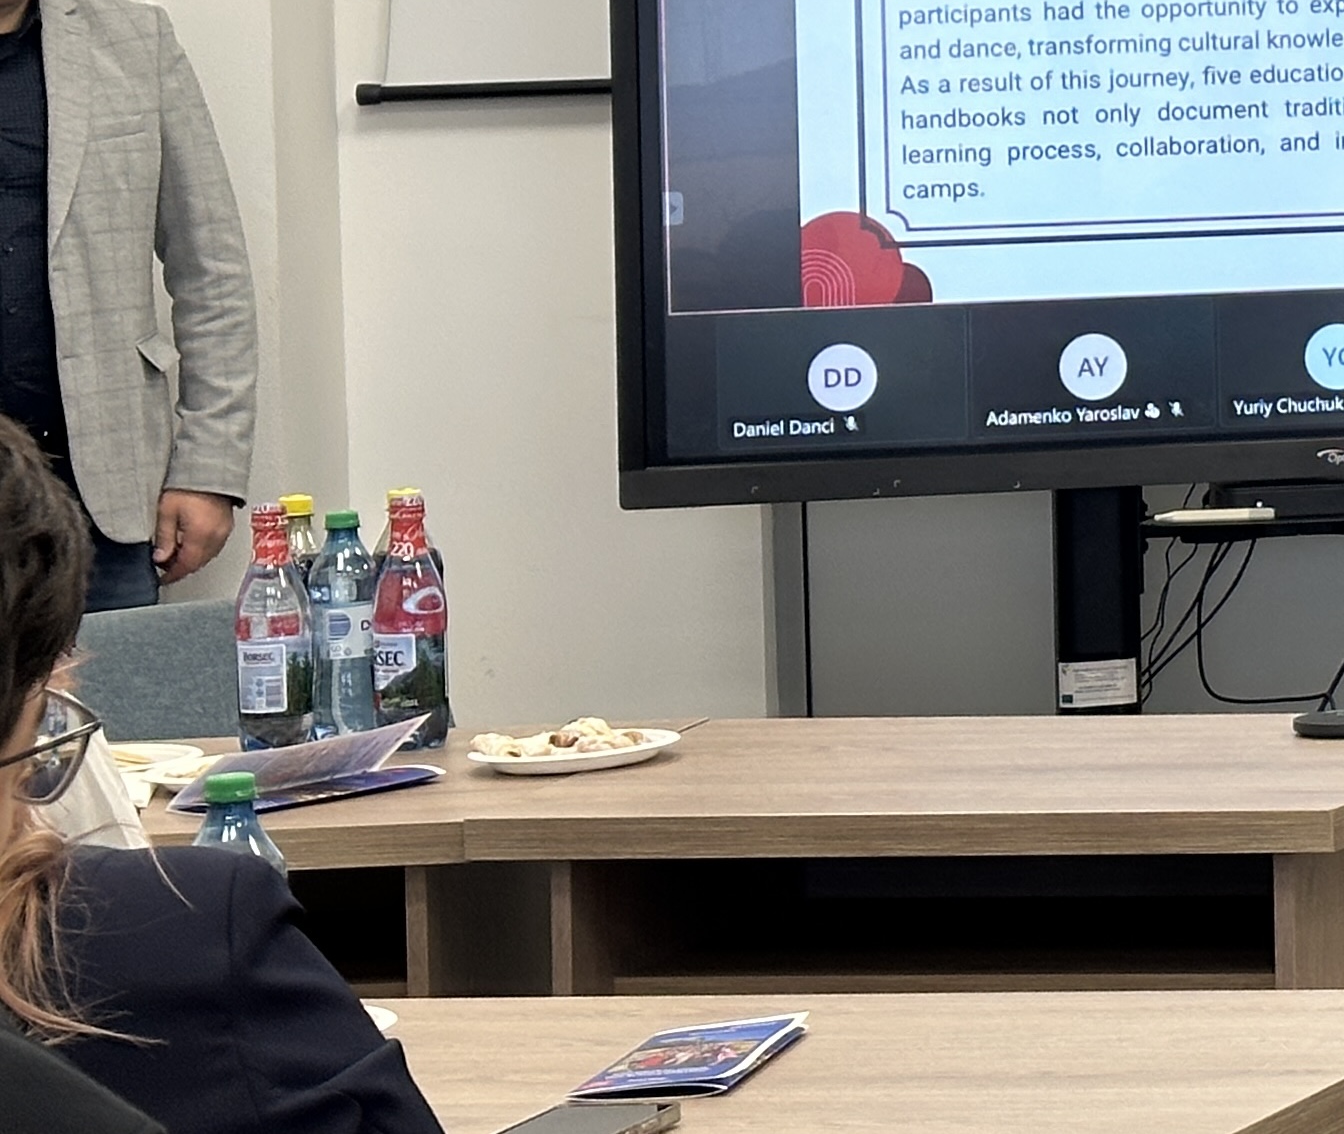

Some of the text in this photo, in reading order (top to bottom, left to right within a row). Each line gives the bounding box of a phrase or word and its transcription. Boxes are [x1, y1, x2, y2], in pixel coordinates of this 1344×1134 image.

[899, 4, 1031, 29] participants
[1044, 0, 1084, 21] had
[1095, 0, 1130, 20] the
[900, 39, 940, 59] and
[949, 38, 1021, 59] dance,
[1028, 34, 1171, 57] transforming
[1178, 30, 1259, 52] cultural
[901, 76, 929, 94] As
[938, 79, 951, 93] a
[960, 72, 1022, 93] result
[1030, 70, 1053, 90] of
[1061, 70, 1101, 90] this
[1107, 69, 1194, 93] journey,
[1202, 65, 1241, 85] five
[901, 106, 1025, 130] handbooks
[1043, 107, 1079, 125] not
[1096, 102, 1141, 127] only
[1158, 101, 1269, 121] document
[903, 144, 991, 167] learning
[1008, 142, 1101, 166] process,
[1116, 134, 1265, 157] collaboration,
[1280, 131, 1319, 152] and
[903, 180, 984, 203] camps.
[823, 368, 862, 389] DD
[1077, 356, 1109, 378] AY
[986, 404, 1140, 428] Adamenko Yaroslav
[1233, 394, 1344, 418] Yuriy Chuchuk
[733, 417, 835, 439] Daniel Danci
